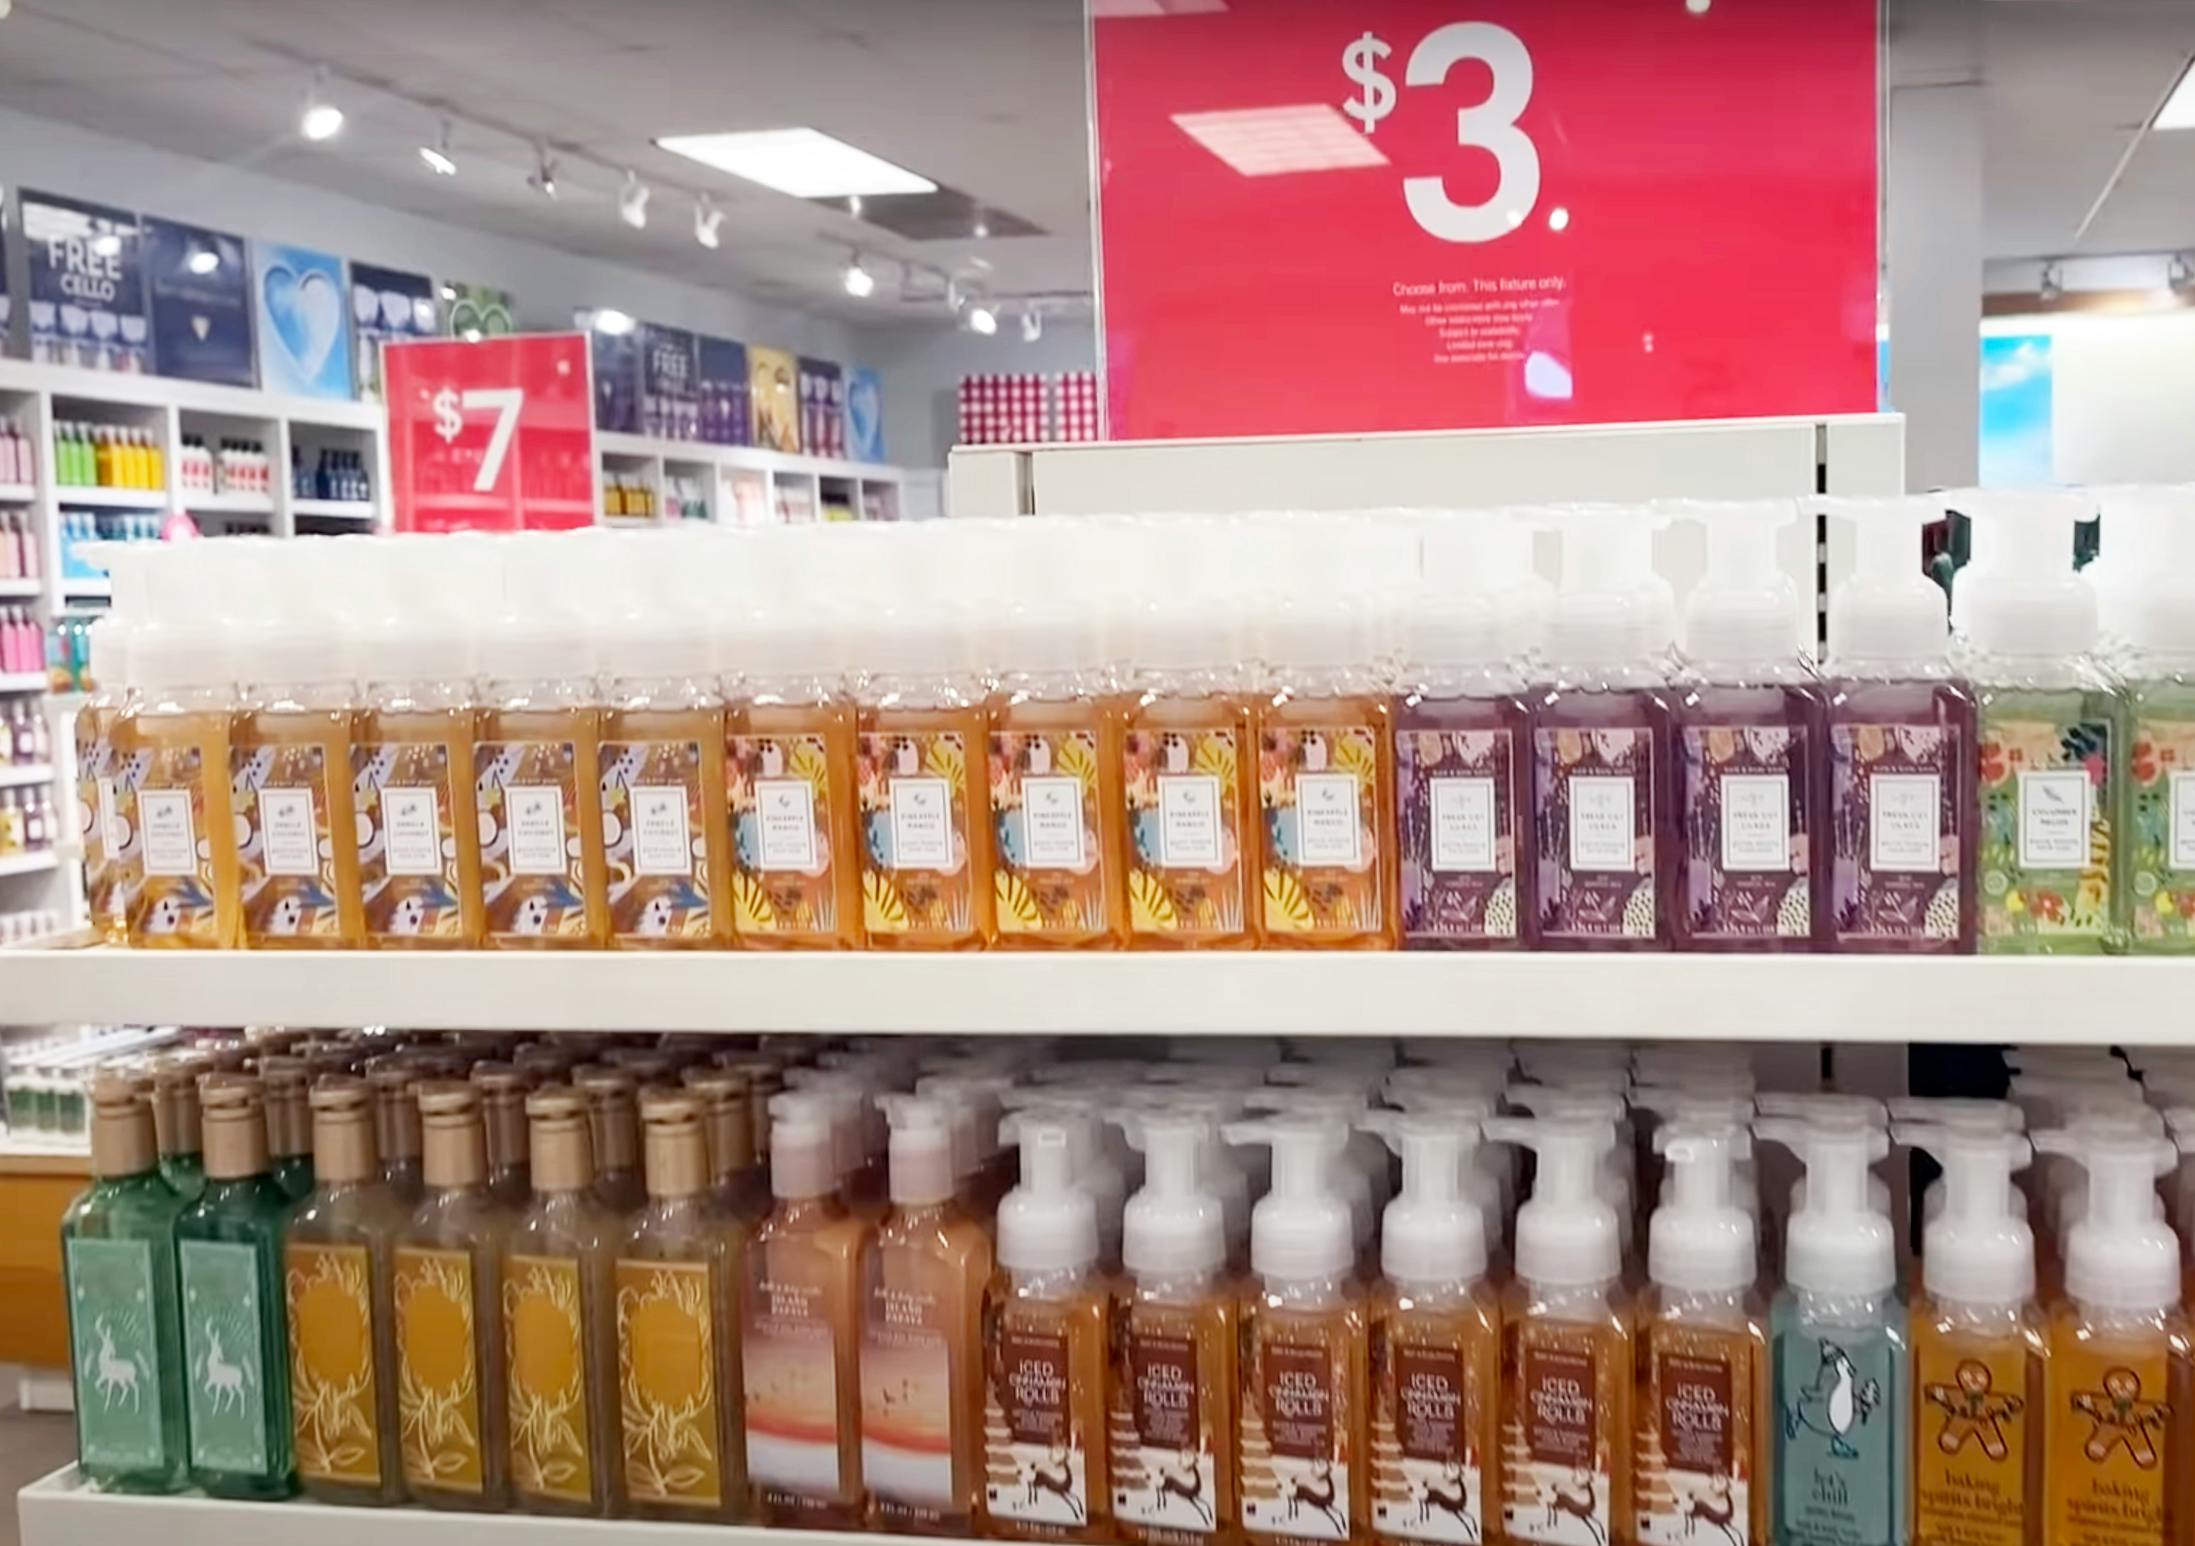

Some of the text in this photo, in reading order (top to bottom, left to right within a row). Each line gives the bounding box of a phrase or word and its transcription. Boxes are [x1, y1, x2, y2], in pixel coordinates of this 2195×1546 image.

[1342, 21, 1541, 244] $3
[49, 237, 123, 282] FREE
[60, 273, 116, 302] CELLO
[1392, 281, 1436, 297] Choose
[1473, 278, 1498, 292] This
[1500, 277, 1537, 291] fixture
[431, 387, 525, 492] $7
[1018, 1359, 1055, 1377] ICED
[1147, 1362, 1183, 1381] ICED
[1279, 1371, 1317, 1389] ICED
[1410, 1372, 1449, 1390] ICED
[1541, 1376, 1581, 1395] ICED
[1677, 1382, 1716, 1401] ICED
